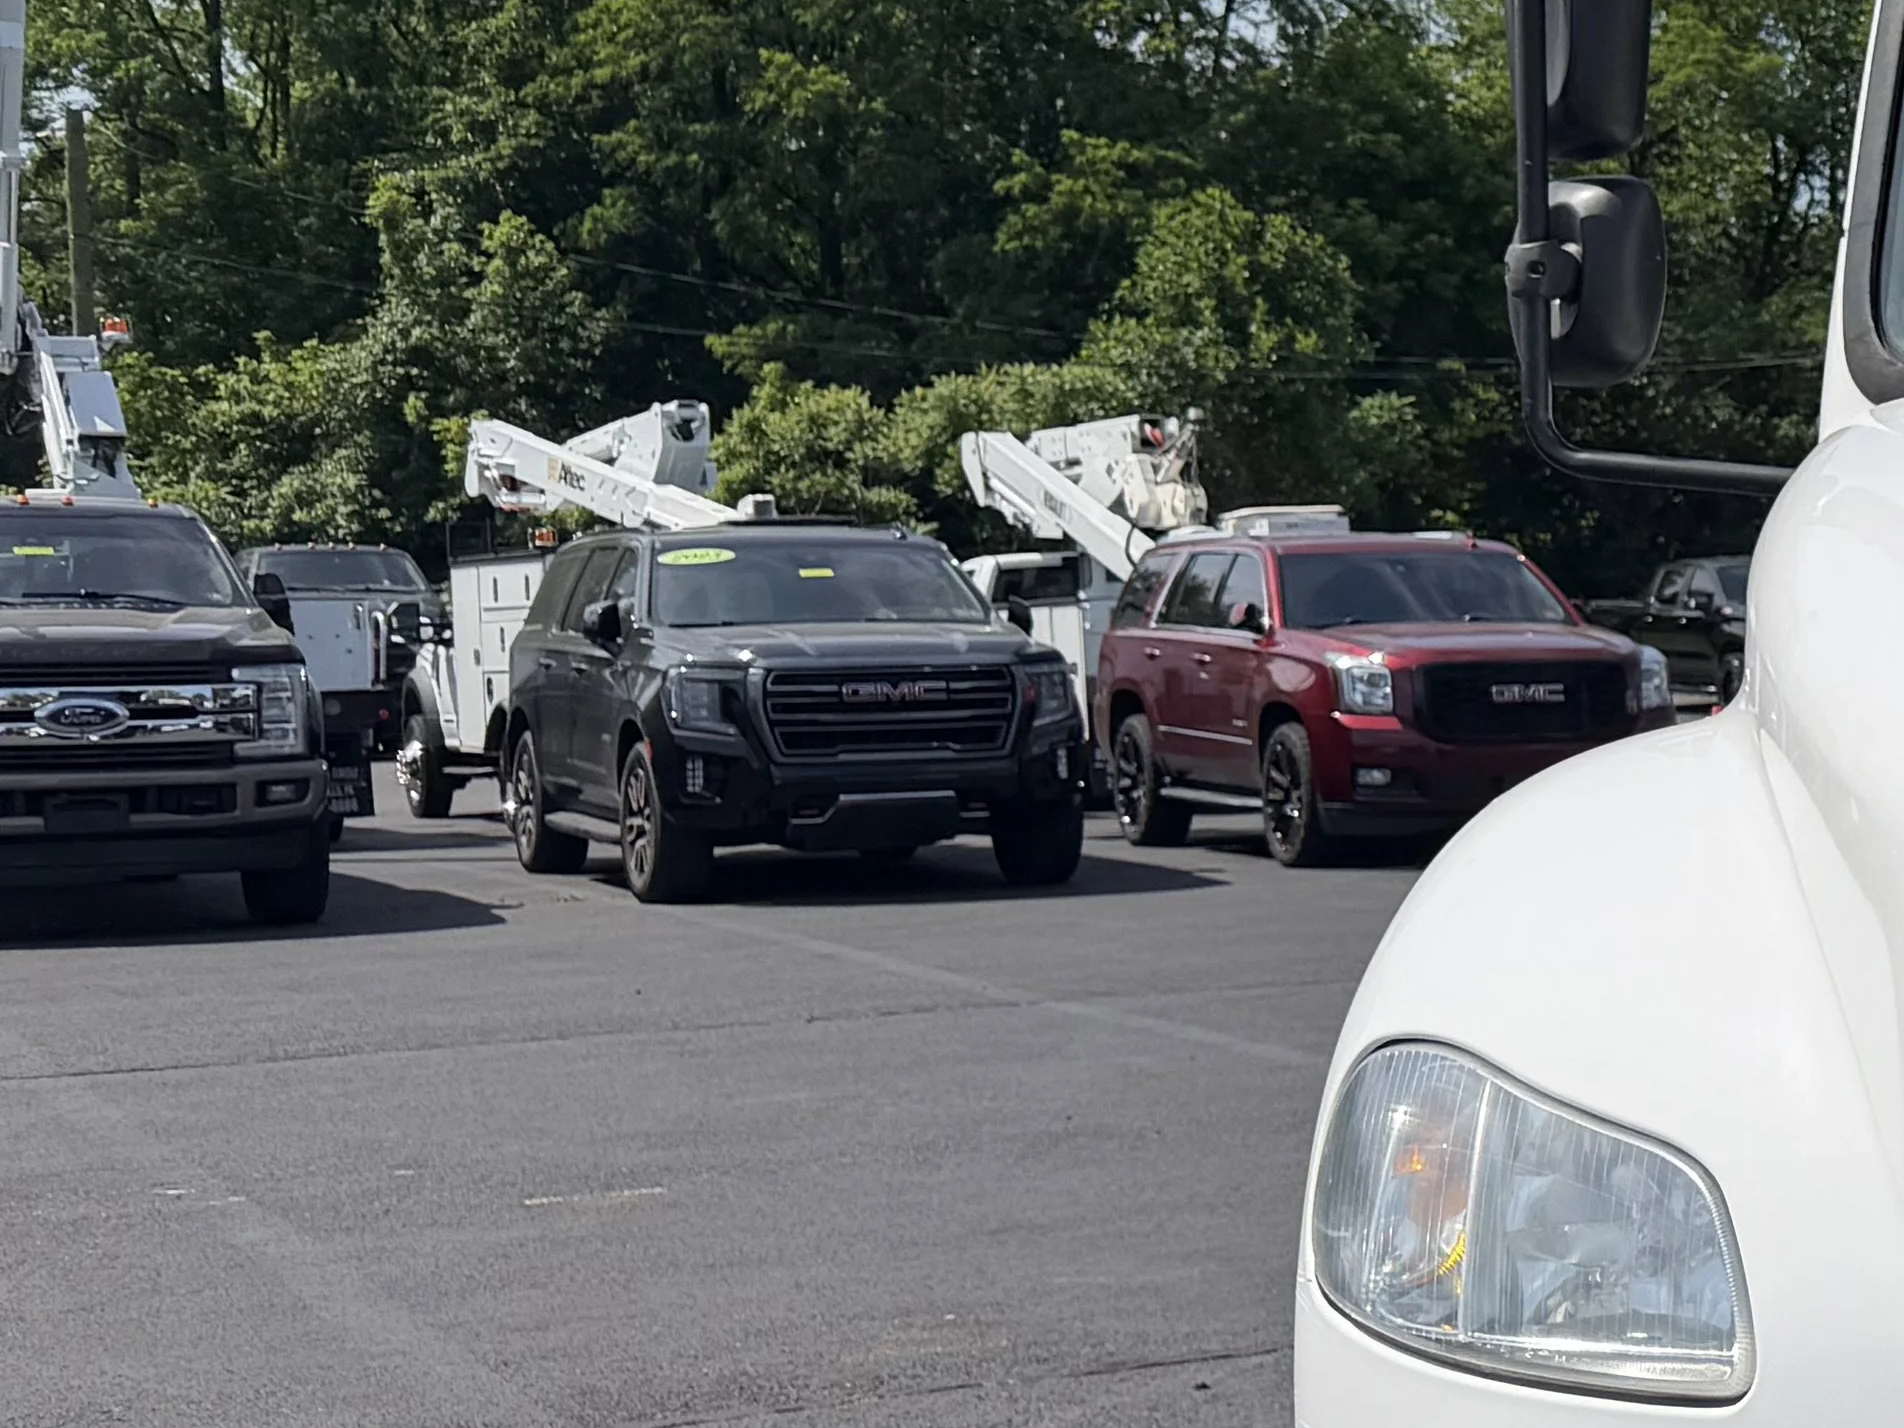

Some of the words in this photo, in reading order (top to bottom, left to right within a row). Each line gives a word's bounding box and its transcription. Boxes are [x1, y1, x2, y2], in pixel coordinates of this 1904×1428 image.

[842, 680, 948, 703] GMC
[1491, 683, 1566, 704] GMC
[60, 706, 106, 724] Ford
